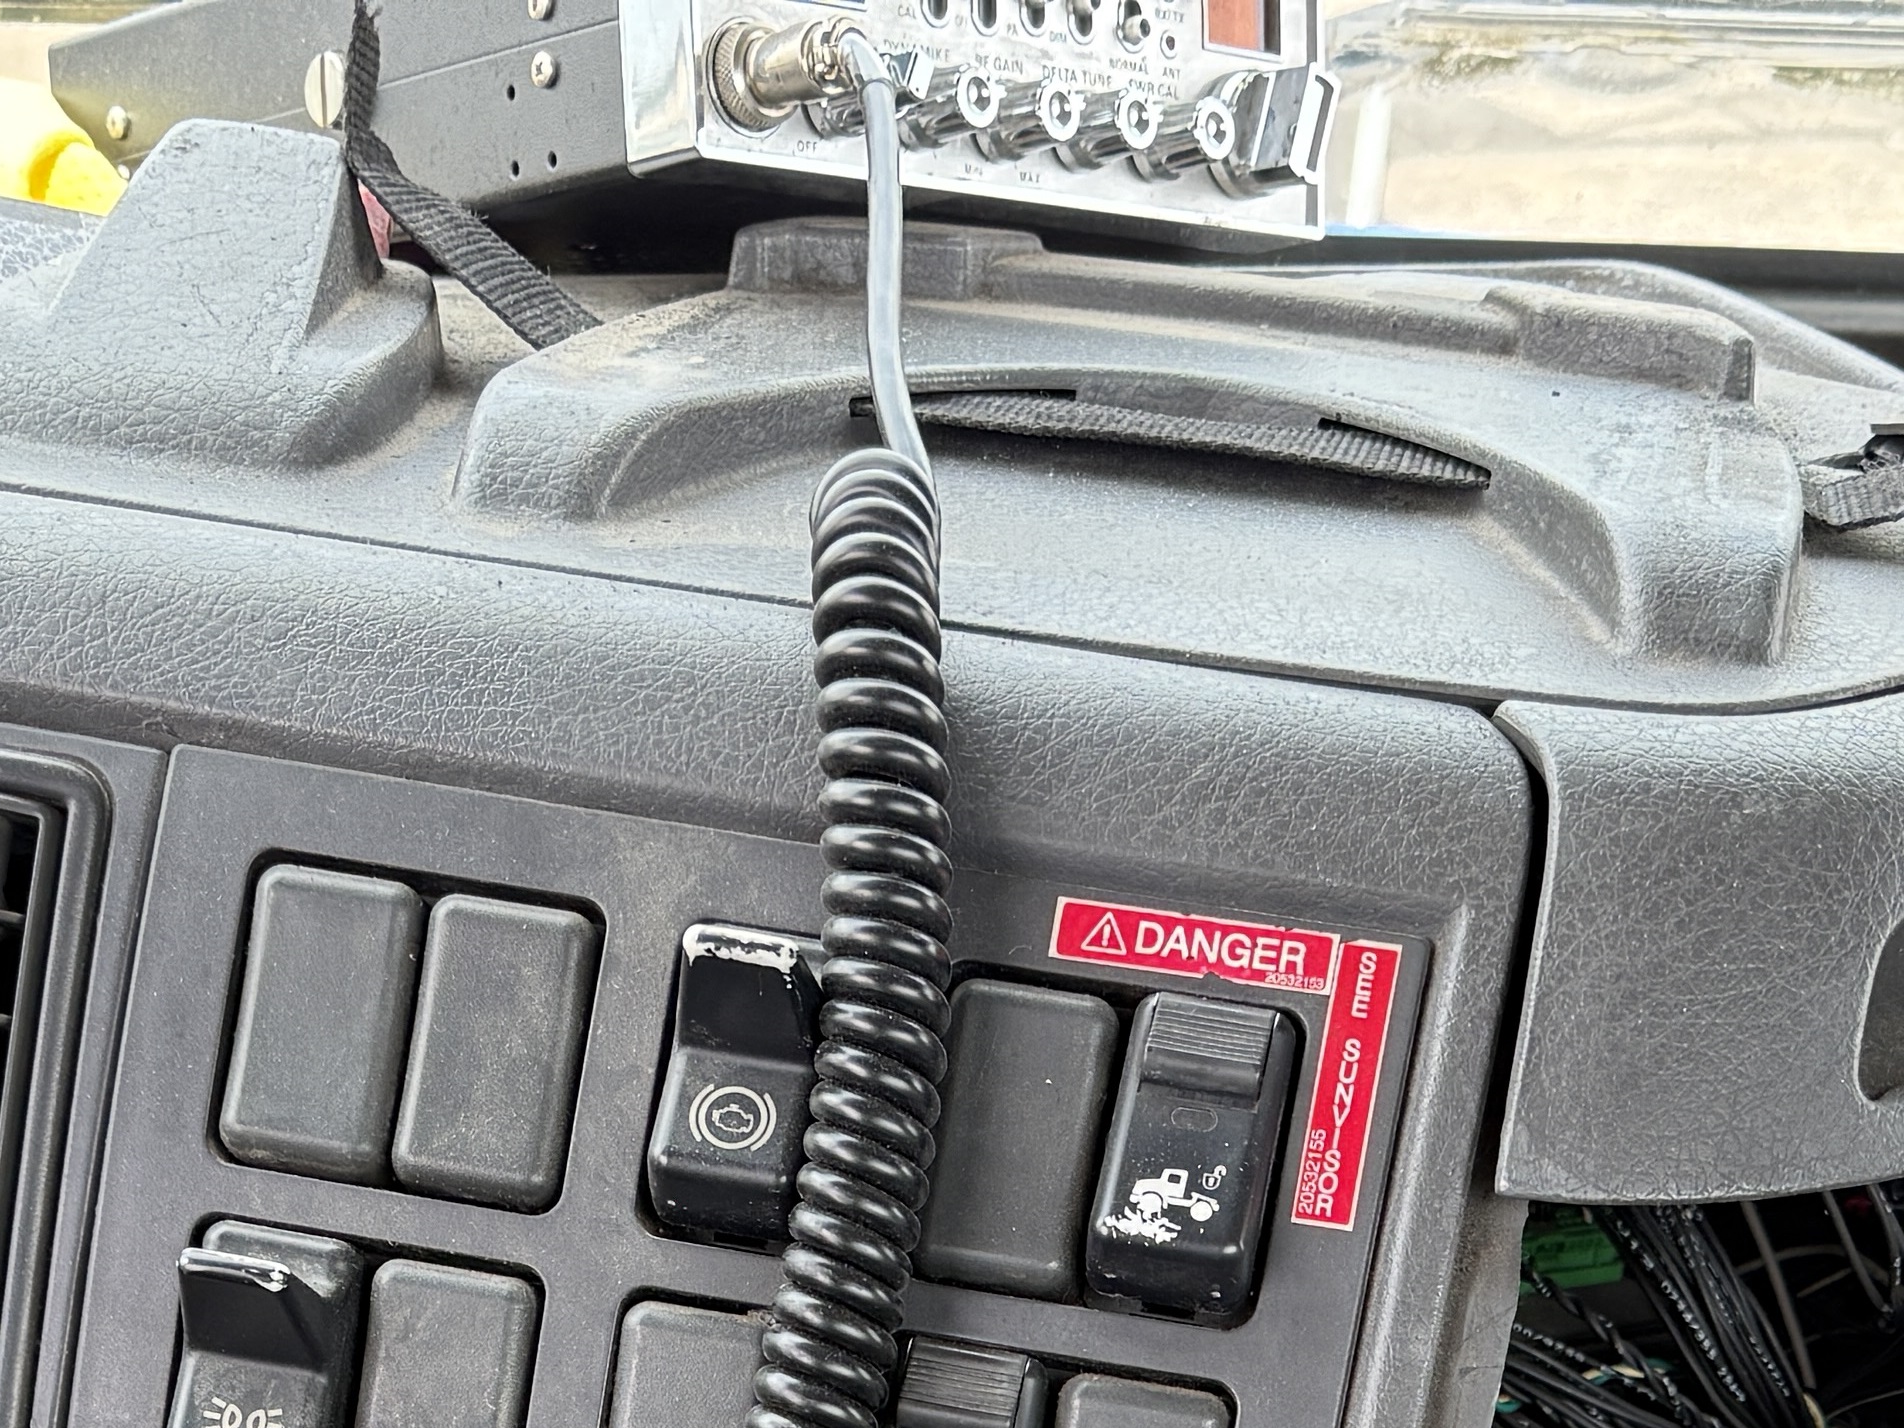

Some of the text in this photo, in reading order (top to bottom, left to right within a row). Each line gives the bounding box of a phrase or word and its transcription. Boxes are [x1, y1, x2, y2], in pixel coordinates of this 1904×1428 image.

[993, 56, 1024, 75] GAIN
[1157, 84, 1179, 100] CAL
[796, 140, 818, 153] OFF
[1134, 920, 1306, 975] DANGER
[1264, 971, 1325, 990] 20532153
[1351, 952, 1377, 1019] SEE
[1297, 1128, 1327, 1216] 20532155
